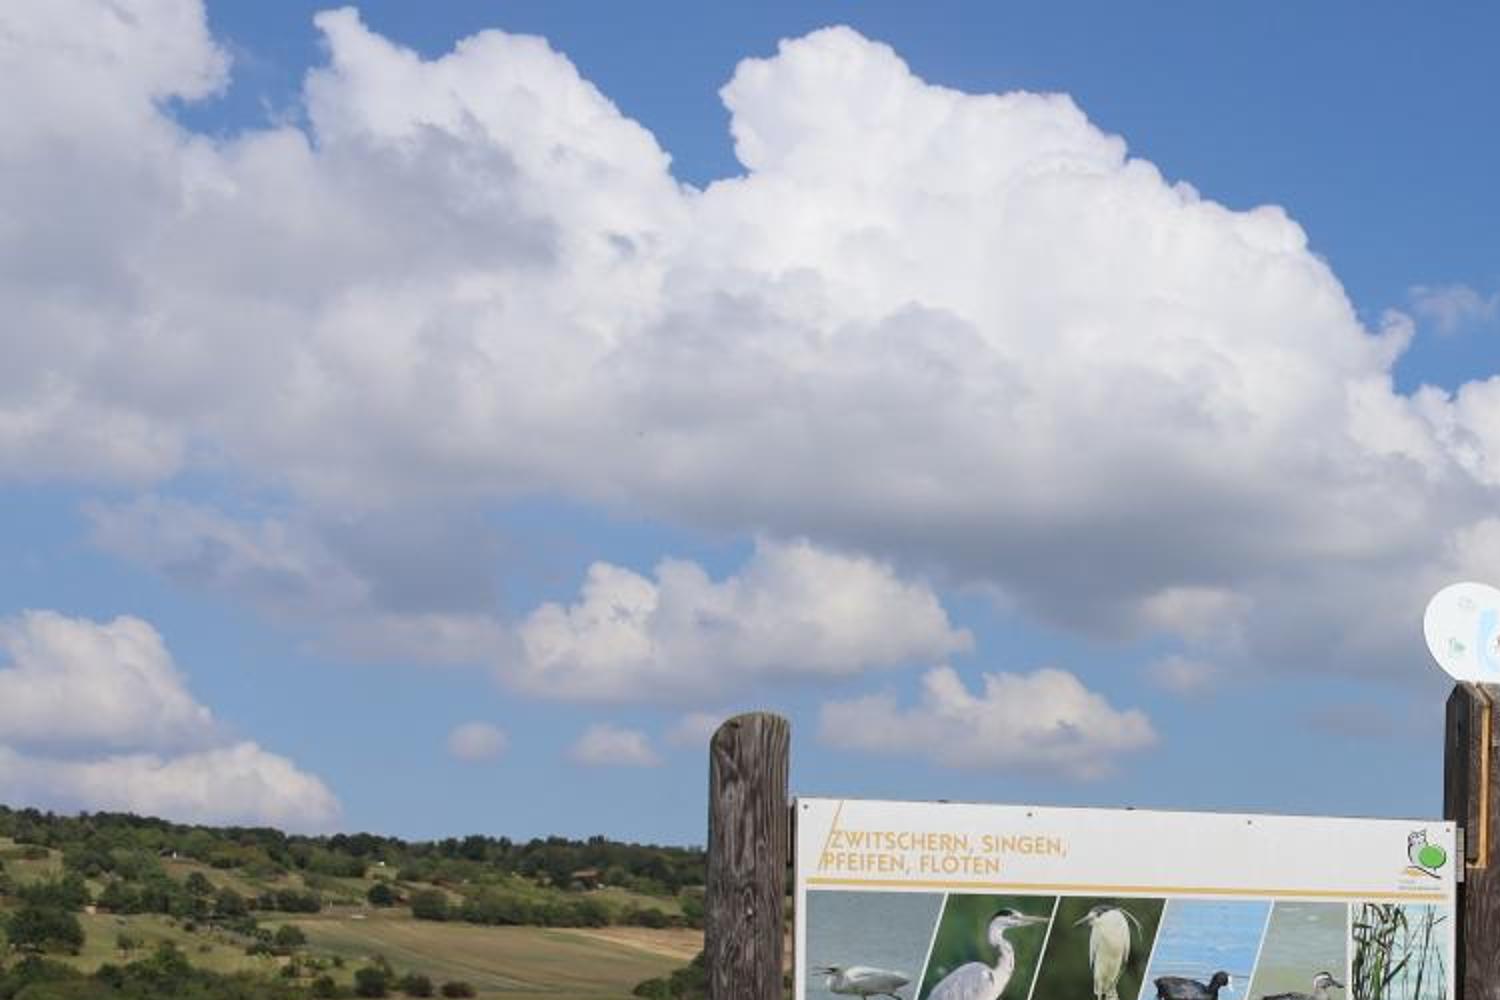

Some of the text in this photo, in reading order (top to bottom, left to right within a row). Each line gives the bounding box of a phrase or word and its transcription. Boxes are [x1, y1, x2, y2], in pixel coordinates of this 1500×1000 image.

[830, 831, 1068, 857] ZWITSCHERN, SINGEN,
[822, 852, 911, 875] PFEIFEN,
